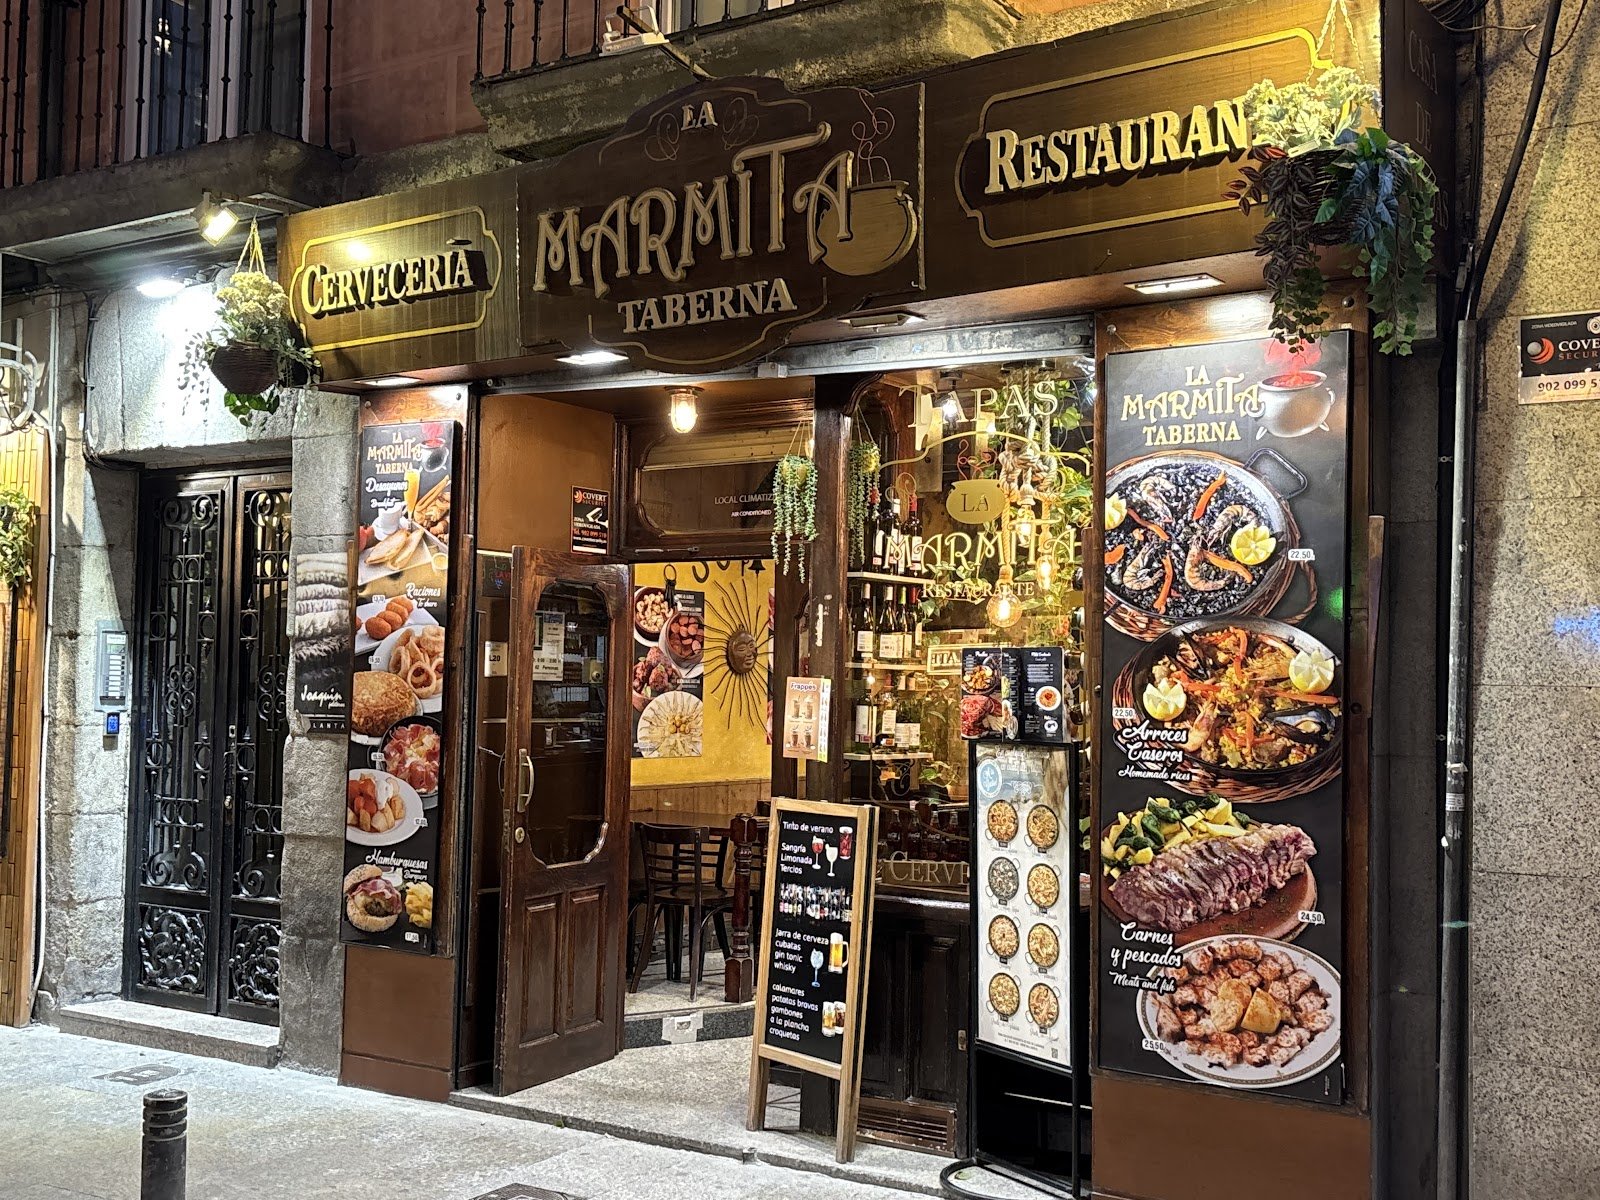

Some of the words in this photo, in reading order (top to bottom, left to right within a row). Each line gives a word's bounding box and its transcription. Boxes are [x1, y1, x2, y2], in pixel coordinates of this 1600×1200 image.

[1408, 30, 1438, 94] CASA
[681, 100, 718, 132] LA
[1416, 101, 1432, 152] DE
[984, 97, 1256, 195] RESTAURAN
[533, 122, 855, 298] MARMITA
[618, 278, 798, 334] TABERNA
[1558, 338, 1600, 352] COVE
[1559, 350, 1598, 360] SECUR
[1185, 365, 1210, 386] LA
[1538, 382, 1560, 392] 902
[1564, 380, 1586, 390] 099
[899, 380, 1058, 428] TAPAS
[1121, 372, 1260, 422] MARMITA
[392, 432, 402, 444] LA
[1142, 421, 1241, 446] TABERNA
[367, 437, 422, 462] MARMITA
[376, 462, 414, 474] TABERNA
[582, 492, 607, 502] COVERT
[714, 496, 738, 504] LOCAL
[740, 494, 774, 502] CLIMATIZ
[960, 494, 990, 512] LA
[406, 583, 441, 598] Raciones
[1122, 720, 1187, 742] Arroces
[1126, 742, 1183, 762] Caseros
[1118, 766, 1169, 780] Homemade
[1170, 772, 1190, 782] rices
[783, 821, 799, 830] Tinto
[800, 823, 808, 832] de
[811, 824, 834, 834] verano
[366, 848, 428, 870] Hamburguesas
[780, 854, 812, 864] Limonada
[890, 850, 969, 885] CERVE
[780, 864, 802, 874] Tercios
[793, 931, 802, 940] de
[802, 934, 829, 946] cerveza
[1120, 922, 1174, 945] Carnes
[775, 940, 801, 951] cubatas
[774, 950, 786, 960] gin
[786, 952, 802, 962] tonic
[1111, 946, 1118, 966] y
[1122, 949, 1182, 970] pescados
[774, 961, 796, 974] whisky
[772, 984, 804, 996] calamares
[1109, 972, 1140, 988] Meats
[1142, 978, 1158, 989] and
[1160, 978, 1175, 993] fish
[771, 1005, 803, 1018] gambones
[772, 994, 796, 1006] patatas
[797, 998, 818, 1012] bravas
[770, 1016, 774, 1024] a
[776, 1016, 783, 1025] la
[784, 1018, 810, 1032] plancha
[769, 1026, 800, 1040] croquetas
